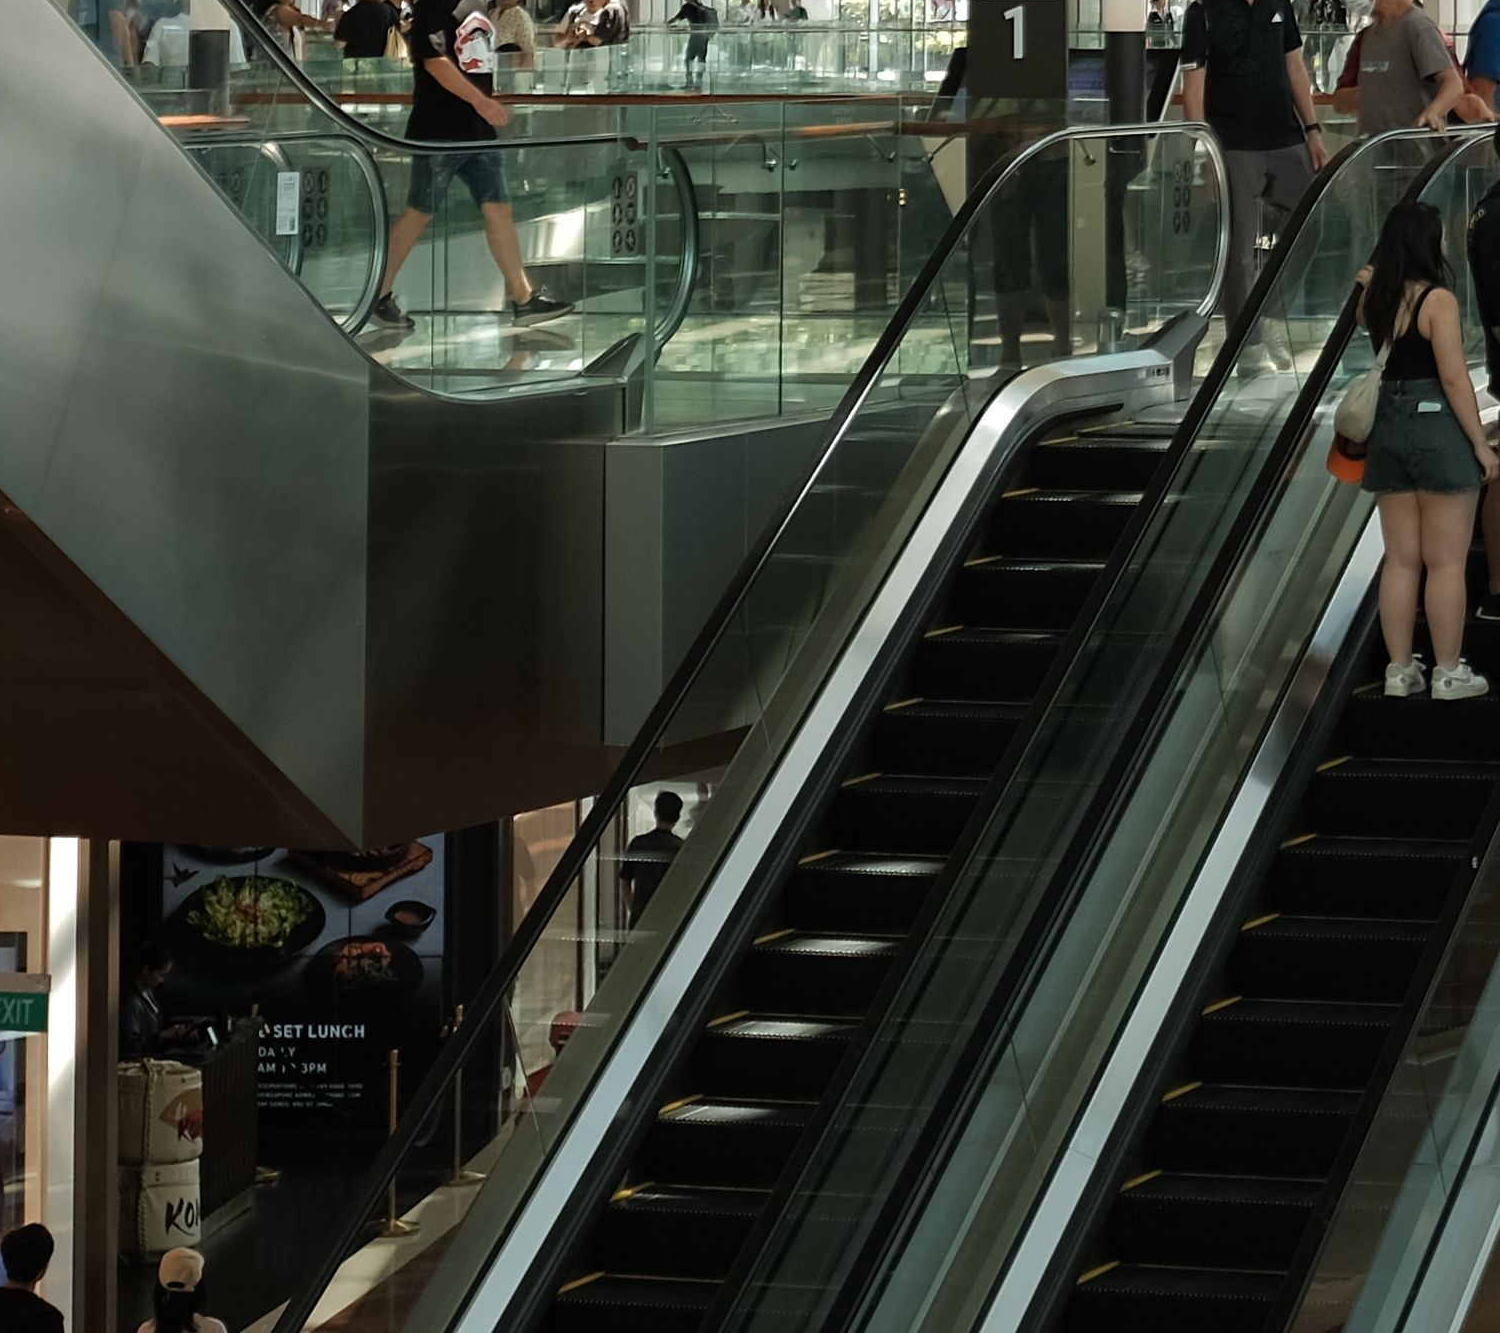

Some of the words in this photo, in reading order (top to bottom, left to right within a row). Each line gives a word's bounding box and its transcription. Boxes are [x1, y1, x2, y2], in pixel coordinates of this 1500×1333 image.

[1002, 4, 1024, 60] 1
[273, 1024, 303, 1039] SET
[307, 1024, 366, 1039] LUNCH
[301, 1062, 327, 1074] 3PM
